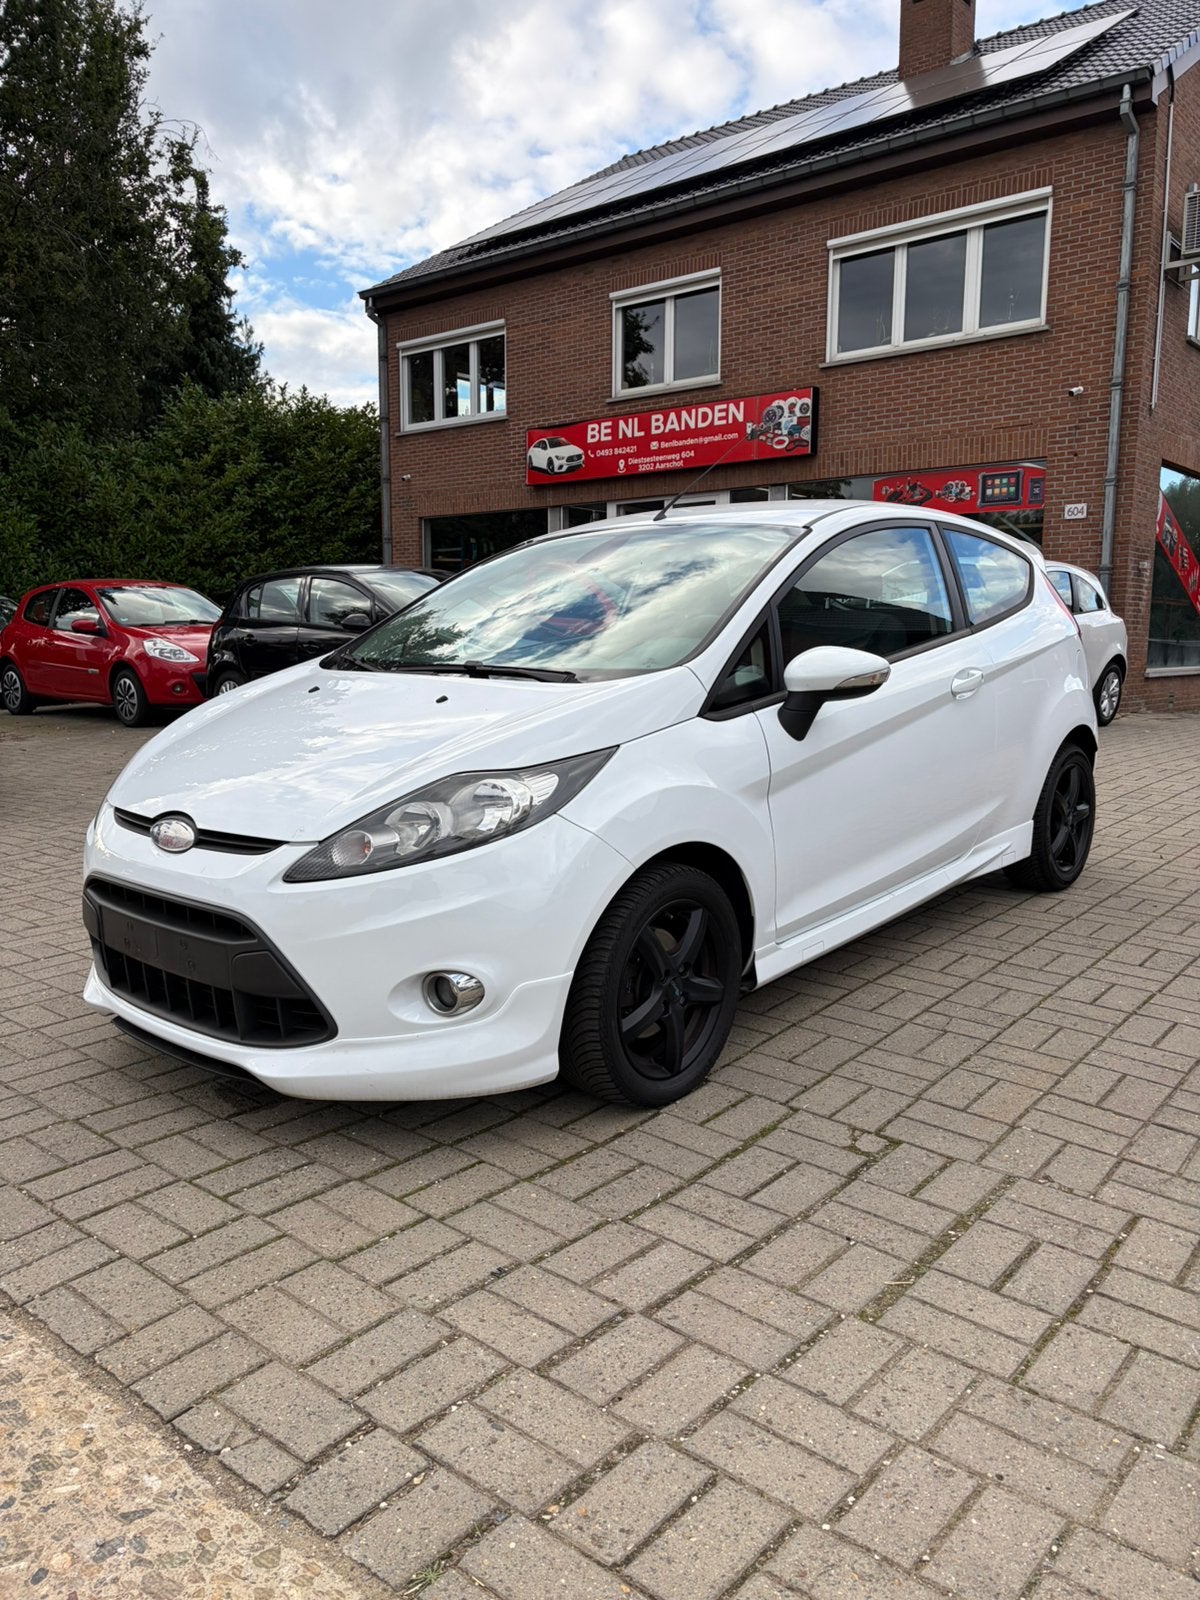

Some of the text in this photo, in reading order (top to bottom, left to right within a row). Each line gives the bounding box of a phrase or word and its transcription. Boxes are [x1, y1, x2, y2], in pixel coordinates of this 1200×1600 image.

[587, 401, 745, 443] BE NL BANDEN
[596, 449, 613, 457] 0493
[681, 450, 695, 459] 604
[638, 463, 654, 472] 3202
[1067, 506, 1084, 516] 604
